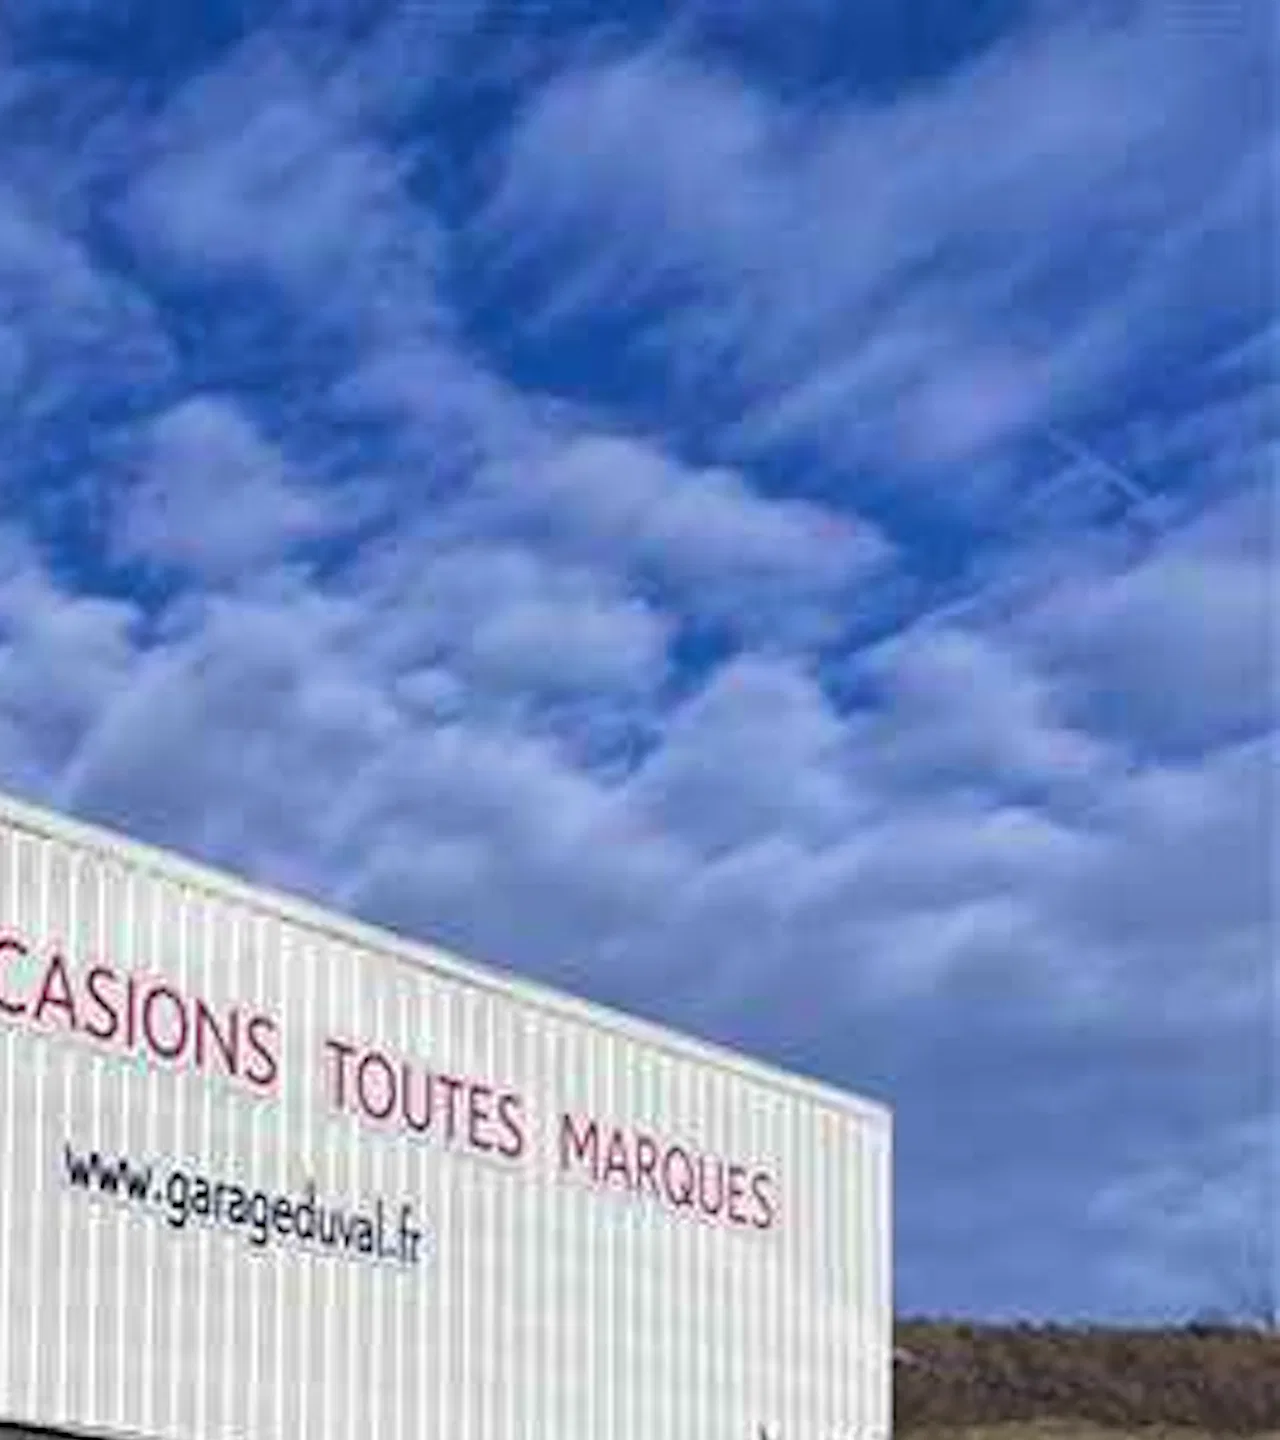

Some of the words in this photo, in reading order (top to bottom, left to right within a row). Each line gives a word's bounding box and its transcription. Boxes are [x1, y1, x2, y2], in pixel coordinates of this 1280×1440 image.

[62, 1142, 421, 1264] www.garageduval.fr
[324, 1039, 523, 1158] TOUTES
[556, 1112, 773, 1230] MARQUES
